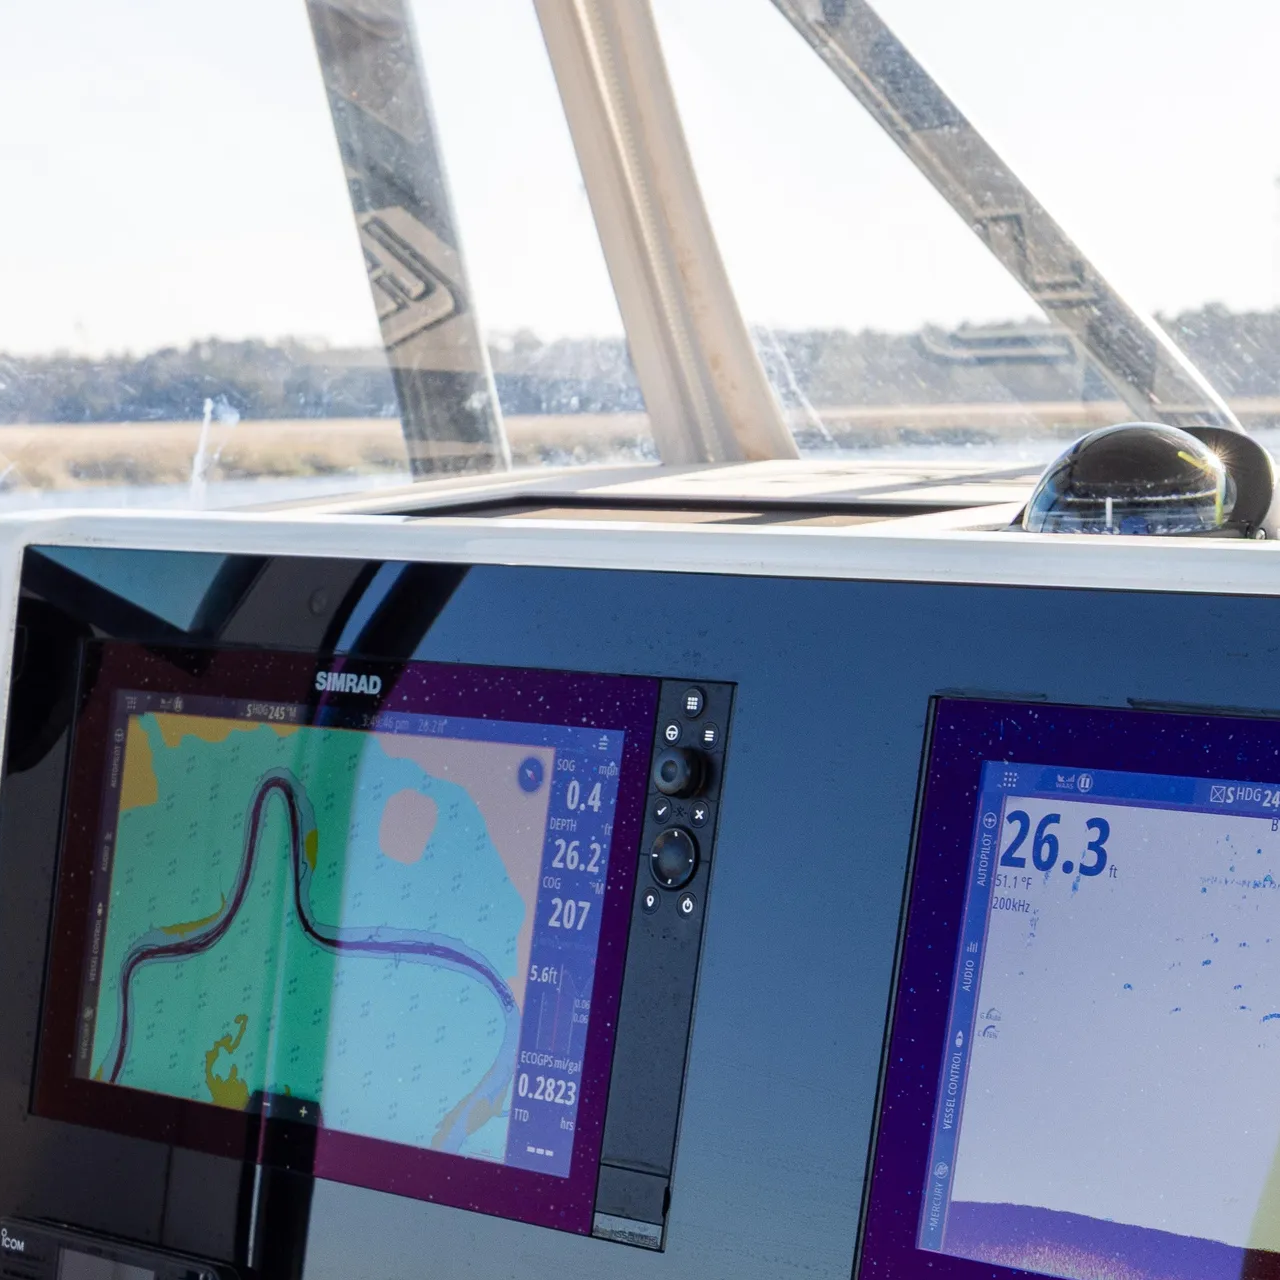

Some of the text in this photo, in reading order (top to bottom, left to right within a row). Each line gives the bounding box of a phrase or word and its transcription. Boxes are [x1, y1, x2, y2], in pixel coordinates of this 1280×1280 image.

[315, 671, 381, 694] SIMRAD
[252, 703, 285, 720] HDG 245
[557, 759, 576, 772] SOG
[599, 763, 618, 778] mph
[566, 780, 601, 812] 0.4
[1236, 787, 1261, 802] HDG
[550, 817, 577, 832] DEPTH
[1000, 809, 1118, 878] 26.3 ft
[552, 839, 601, 873] 26.2
[977, 833, 993, 887] AUTOPILOT
[543, 876, 561, 890] COG
[995, 874, 1032, 890] 51.1 °F
[548, 898, 591, 930] 207
[993, 896, 1031, 913] 200kHz
[530, 965, 558, 985] 5.6ft
[962, 959, 975, 992] AUDIO
[521, 1051, 581, 1076] ECOGPS mi/gal
[518, 1073, 577, 1106] 0.2823
[943, 1051, 963, 1130] VESSEL CONTROL
[514, 1108, 529, 1122] TTD
[560, 1117, 574, 1130] hrs
[930, 1181, 943, 1228] MERCURY
